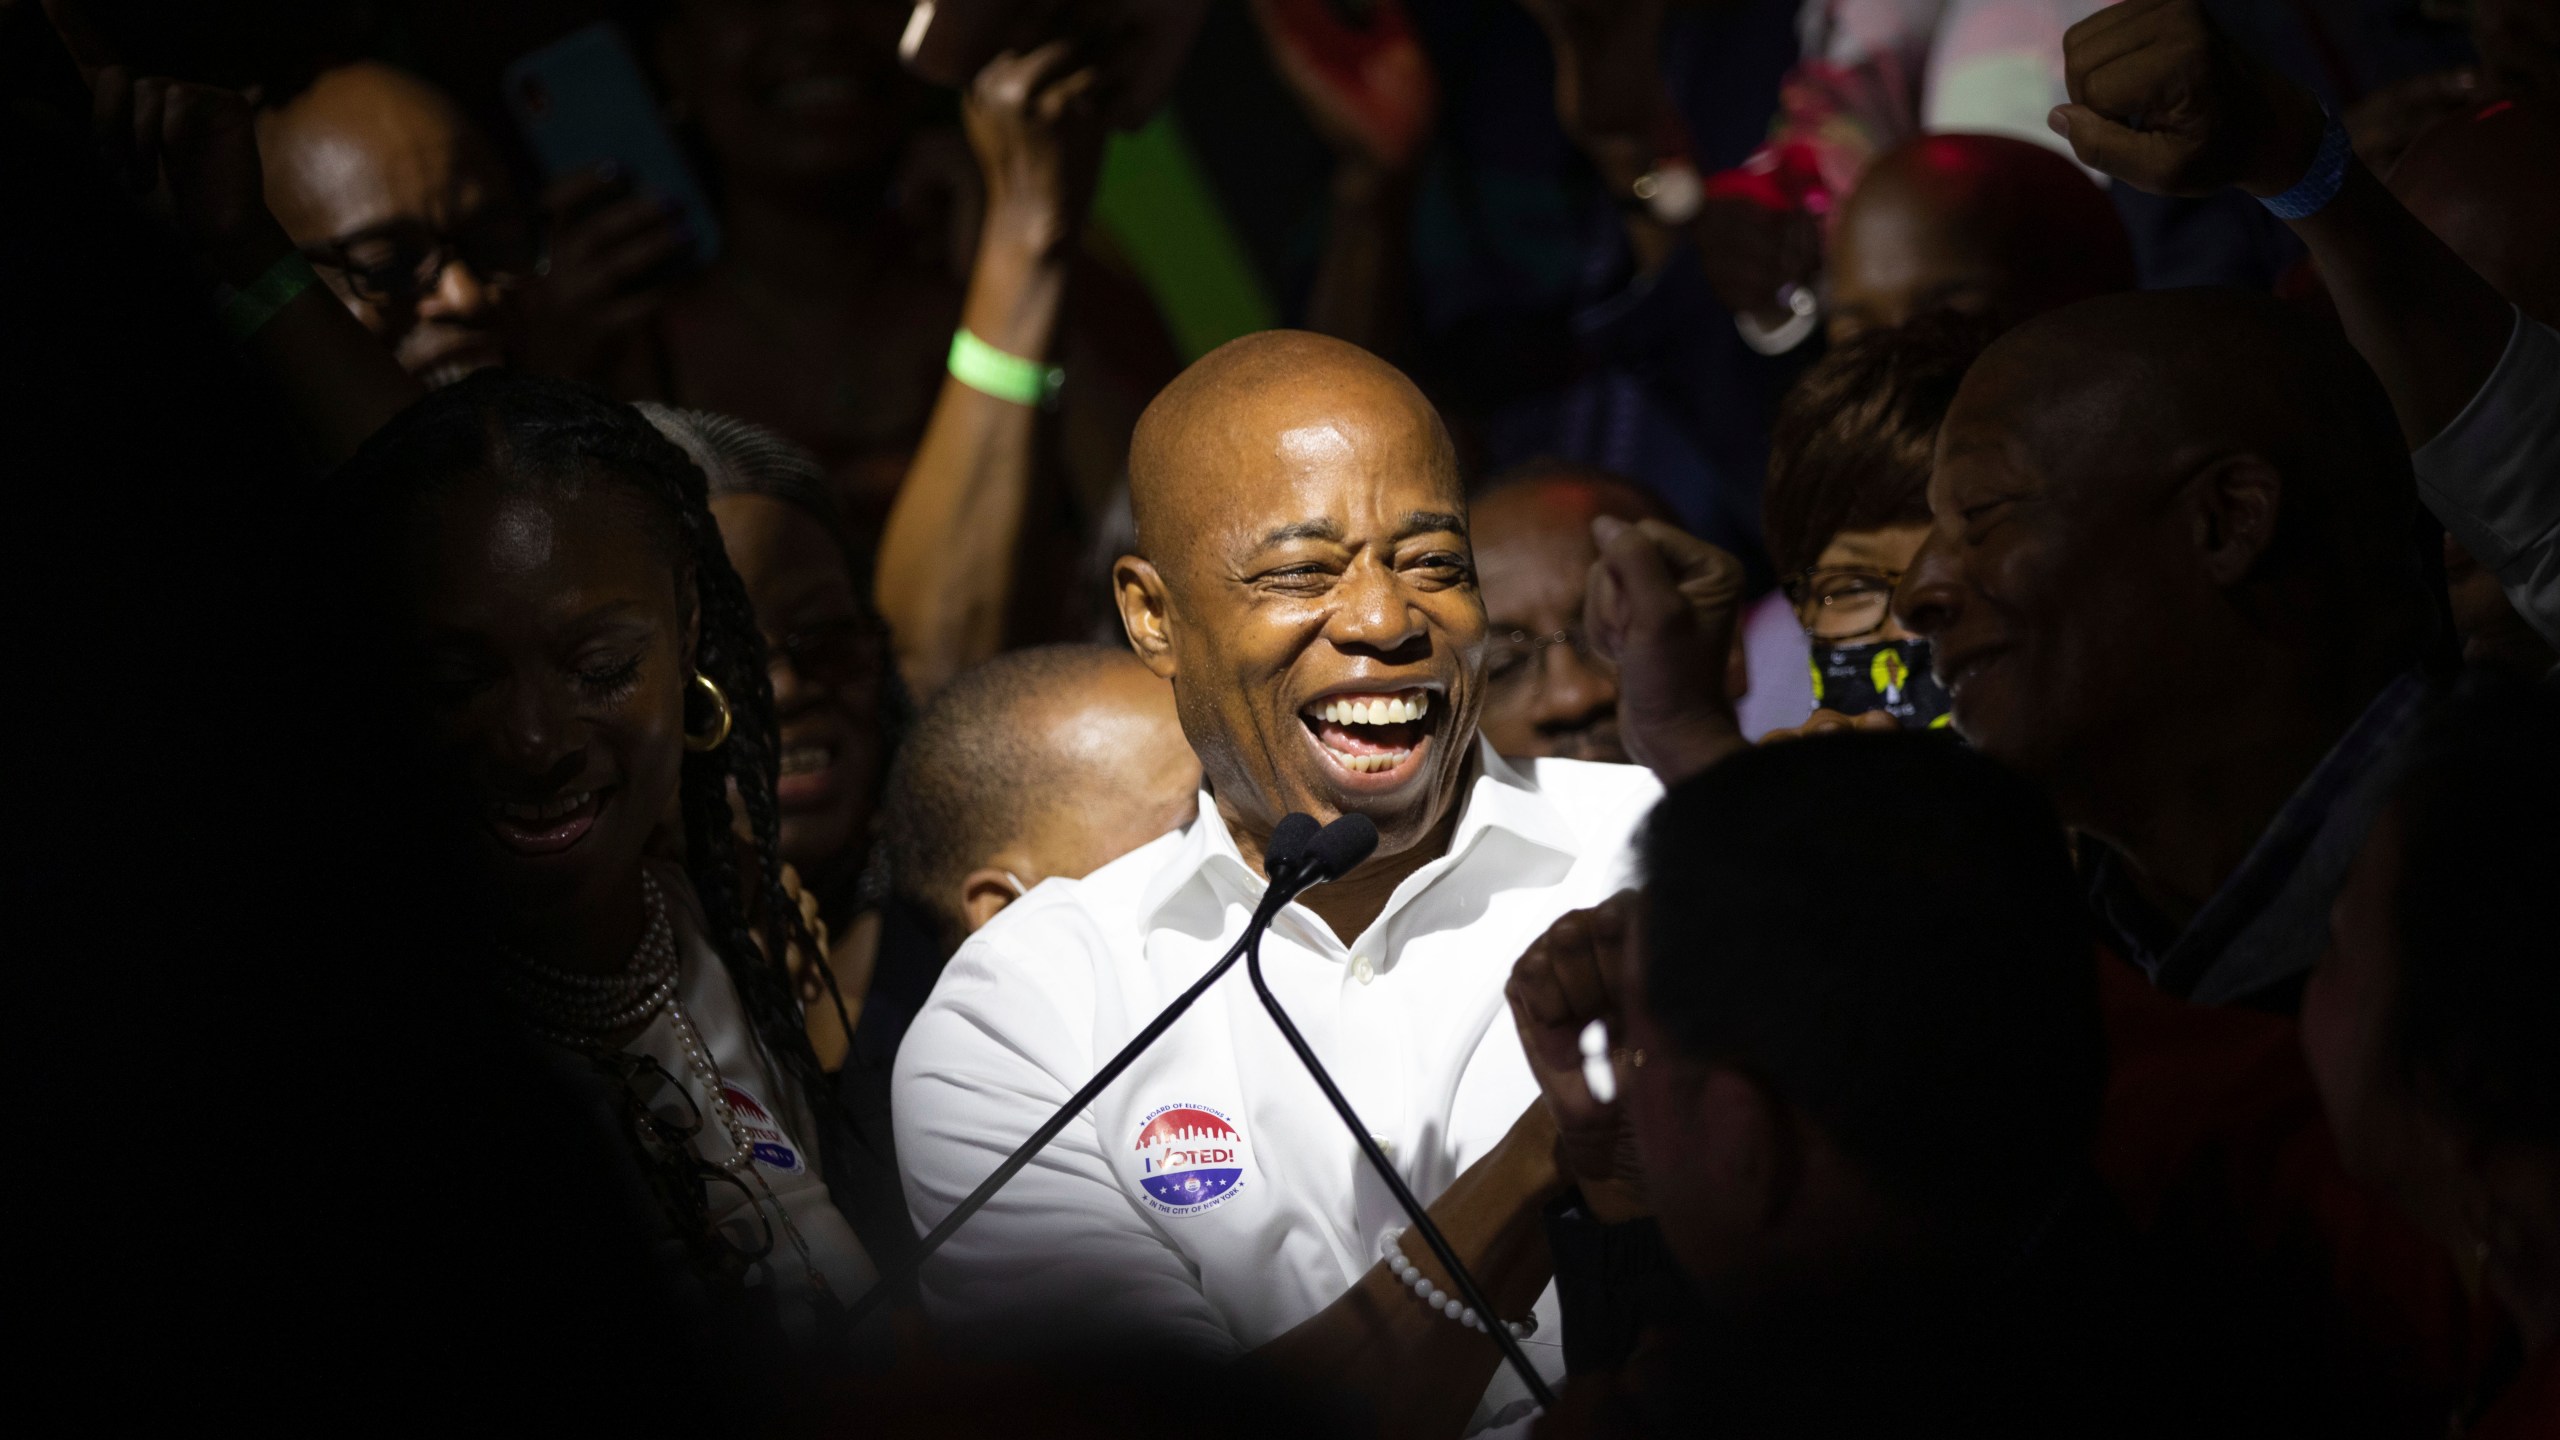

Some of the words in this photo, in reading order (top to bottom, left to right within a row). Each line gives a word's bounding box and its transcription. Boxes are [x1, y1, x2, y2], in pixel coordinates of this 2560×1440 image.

[1146, 1105, 1171, 1121] BOARD
[1185, 1103, 1225, 1118] ELECTIONS
[1145, 1158, 1151, 1173] I
[1156, 1148, 1234, 1169] VOTED!
[1149, 1200, 1157, 1209] IN
[1158, 1203, 1170, 1213] THE
[1172, 1207, 1189, 1215] CITY
[1191, 1205, 1202, 1213] OF
[1203, 1199, 1220, 1210] NEW
[1221, 1187, 1240, 1201] YORK
